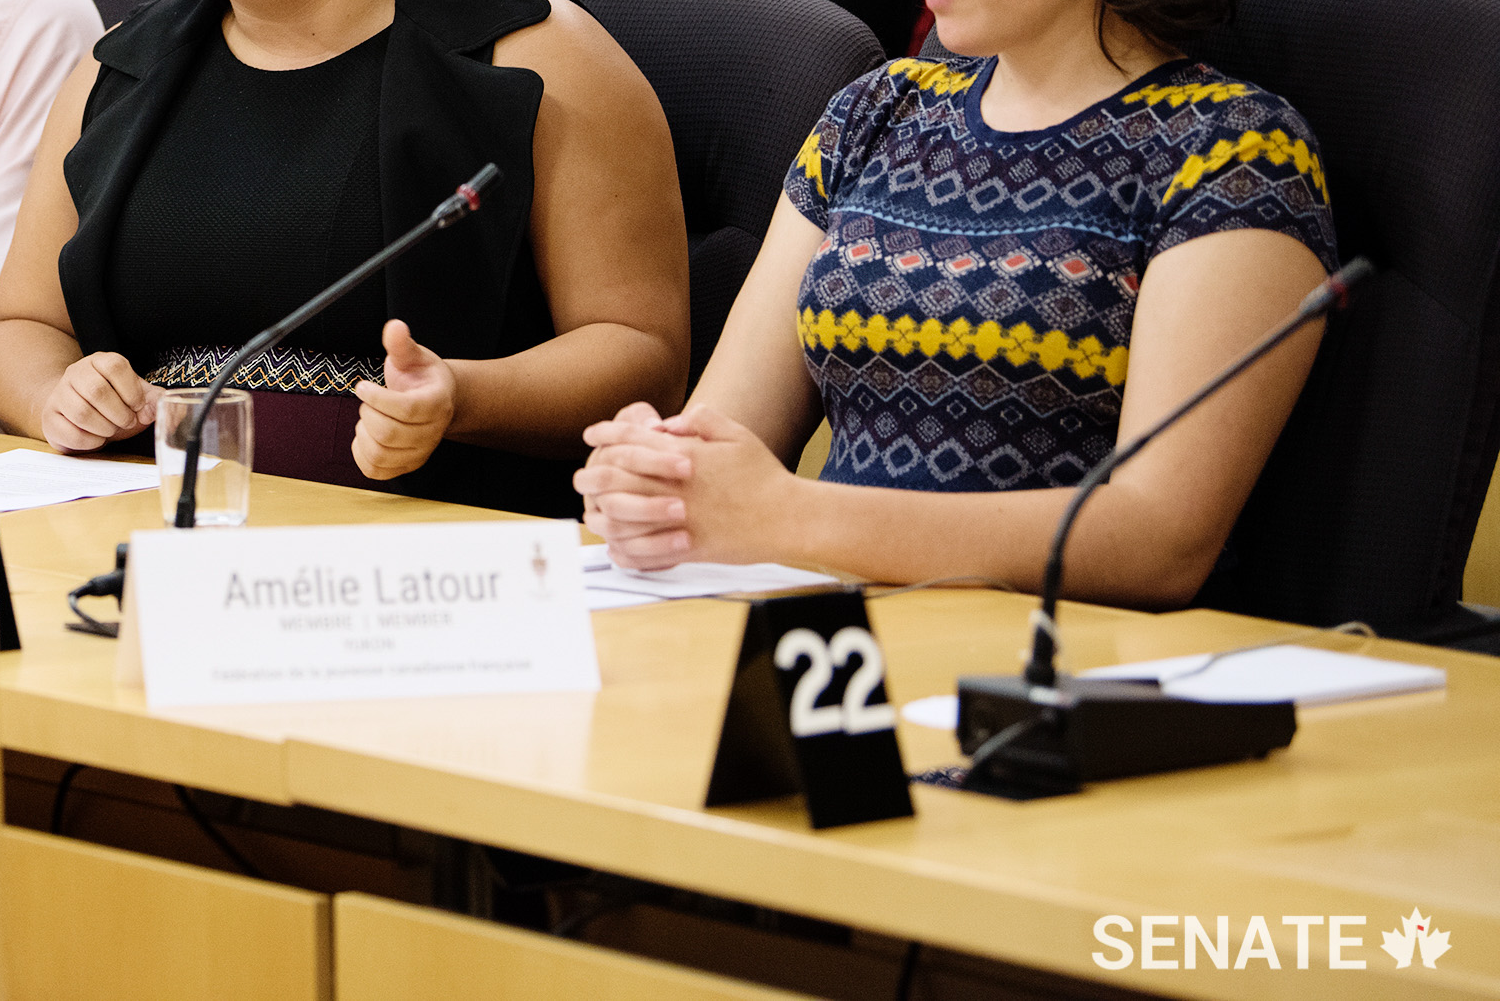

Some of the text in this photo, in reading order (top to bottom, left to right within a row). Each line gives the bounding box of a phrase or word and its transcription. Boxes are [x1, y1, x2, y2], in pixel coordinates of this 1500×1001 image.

[223, 567, 500, 608] Amélie Latour
[773, 626, 897, 737] 22
